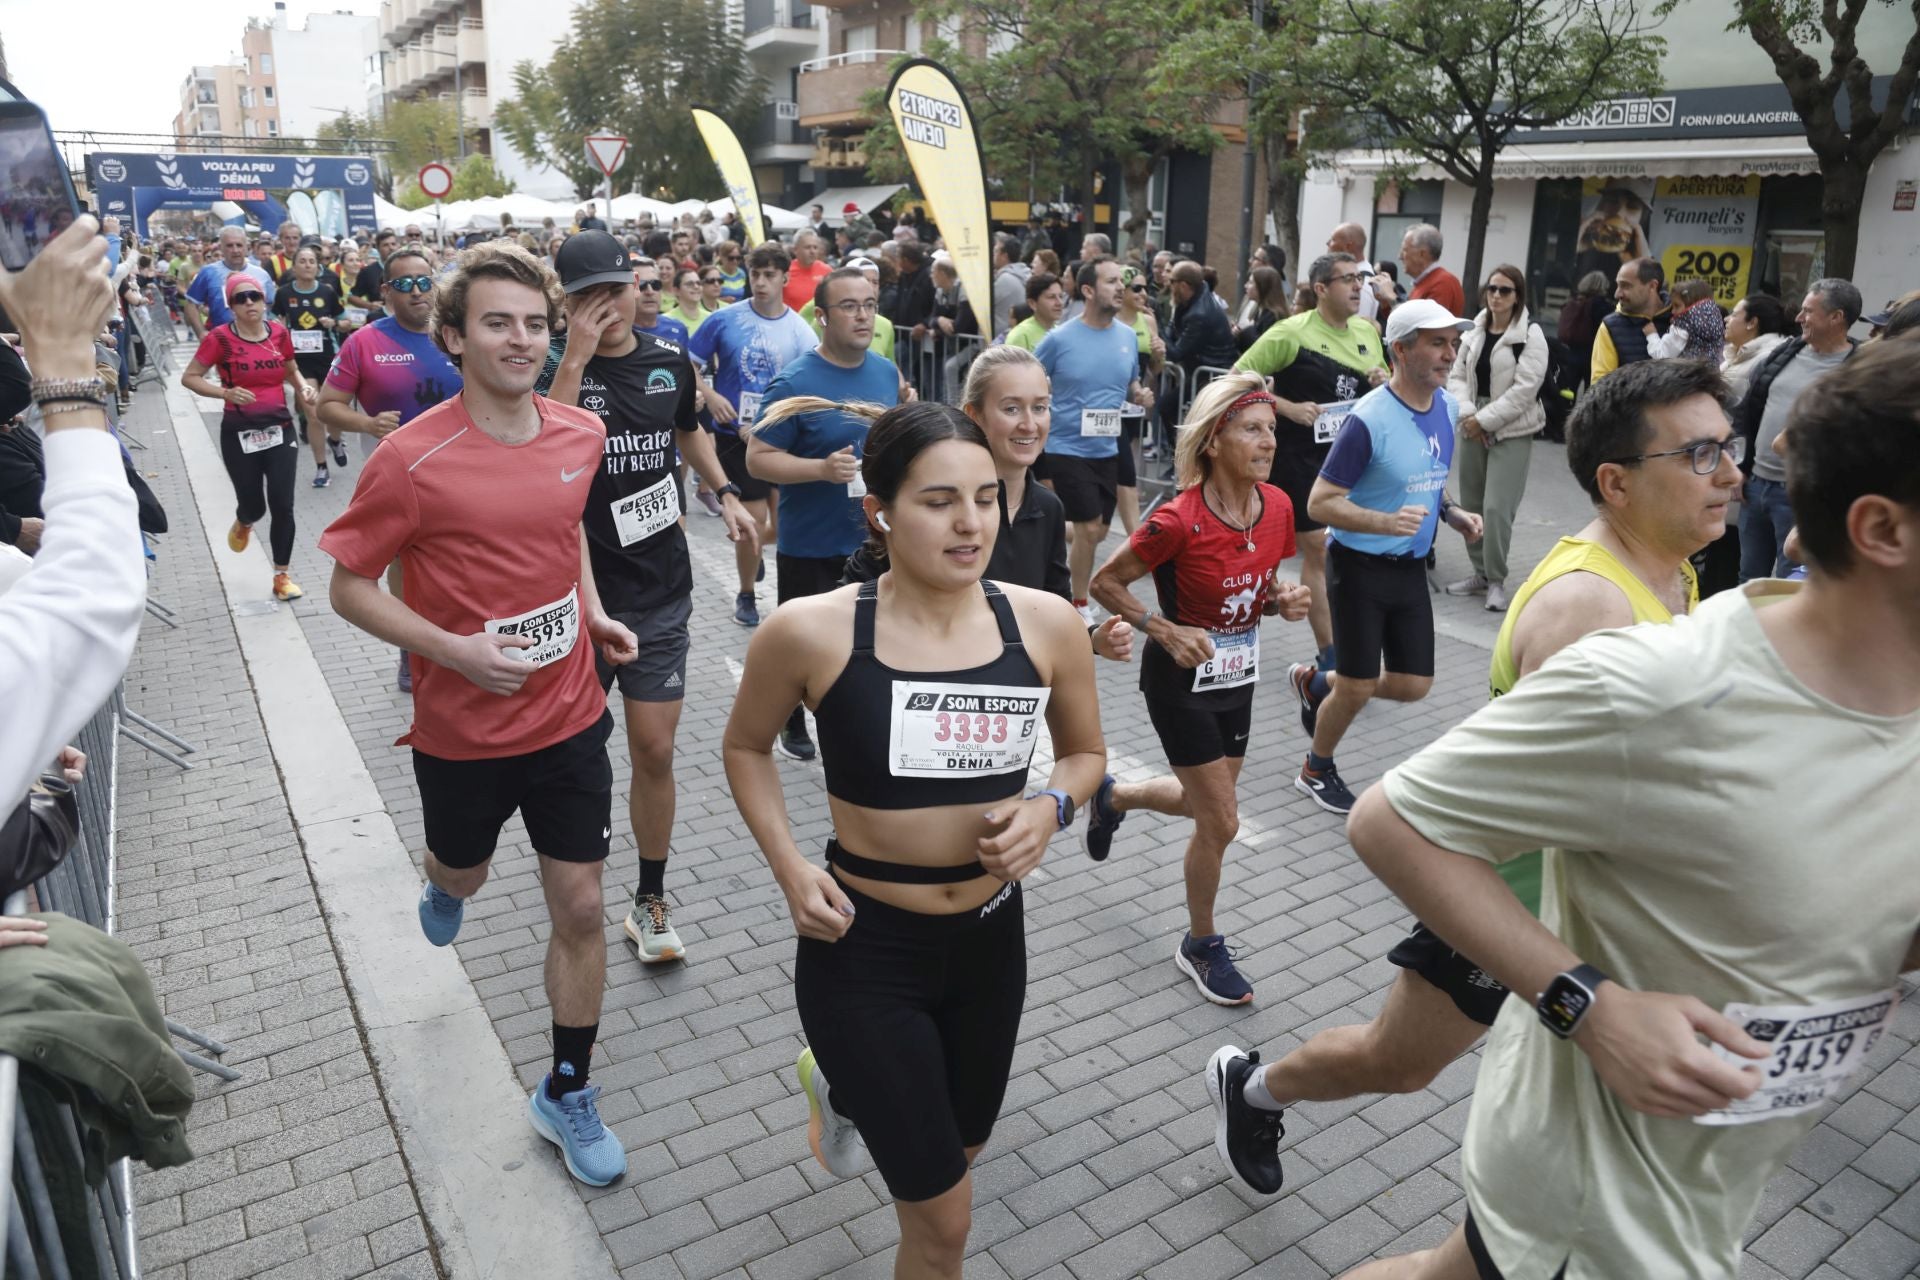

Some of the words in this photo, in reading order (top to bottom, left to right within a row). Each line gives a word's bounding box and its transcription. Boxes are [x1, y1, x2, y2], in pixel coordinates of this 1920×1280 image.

[202, 161, 240, 171] VOLTA
[241, 162, 250, 171] A
[251, 163, 275, 172] PEU
[1741, 161, 1800, 173] PuraMasa
[219, 171, 262, 184] DÉNIA
[1668, 183, 1745, 195] APERTURA
[1663, 206, 1746, 225] Fanneli's
[1708, 223, 1744, 235] burgers
[1675, 250, 1740, 276] 200
[603, 428, 672, 454] mirates
[607, 455, 626, 475] FLY
[630, 450, 665, 472] BETTER
[637, 494, 653, 506] SOM
[653, 482, 671, 498] ESPORT
[635, 496, 668, 522] 3592
[1222, 573, 1252, 588] CLUB
[523, 616, 545, 630] SOM
[546, 602, 573, 621] ESPORT
[1204, 661, 1214, 674] G
[1221, 655, 1243, 673] 143
[947, 696, 980, 710] SOM
[984, 698, 1035, 713] ESPORT
[934, 712, 1008, 744] 3333
[1023, 722, 1032, 735] S
[955, 743, 984, 751] RAQUEL
[947, 754, 993, 769] DÉNIA
[980, 881, 1012, 918] NIKE
[1792, 1017, 1833, 1038] SOM
[1769, 1032, 1855, 1078] 3459
